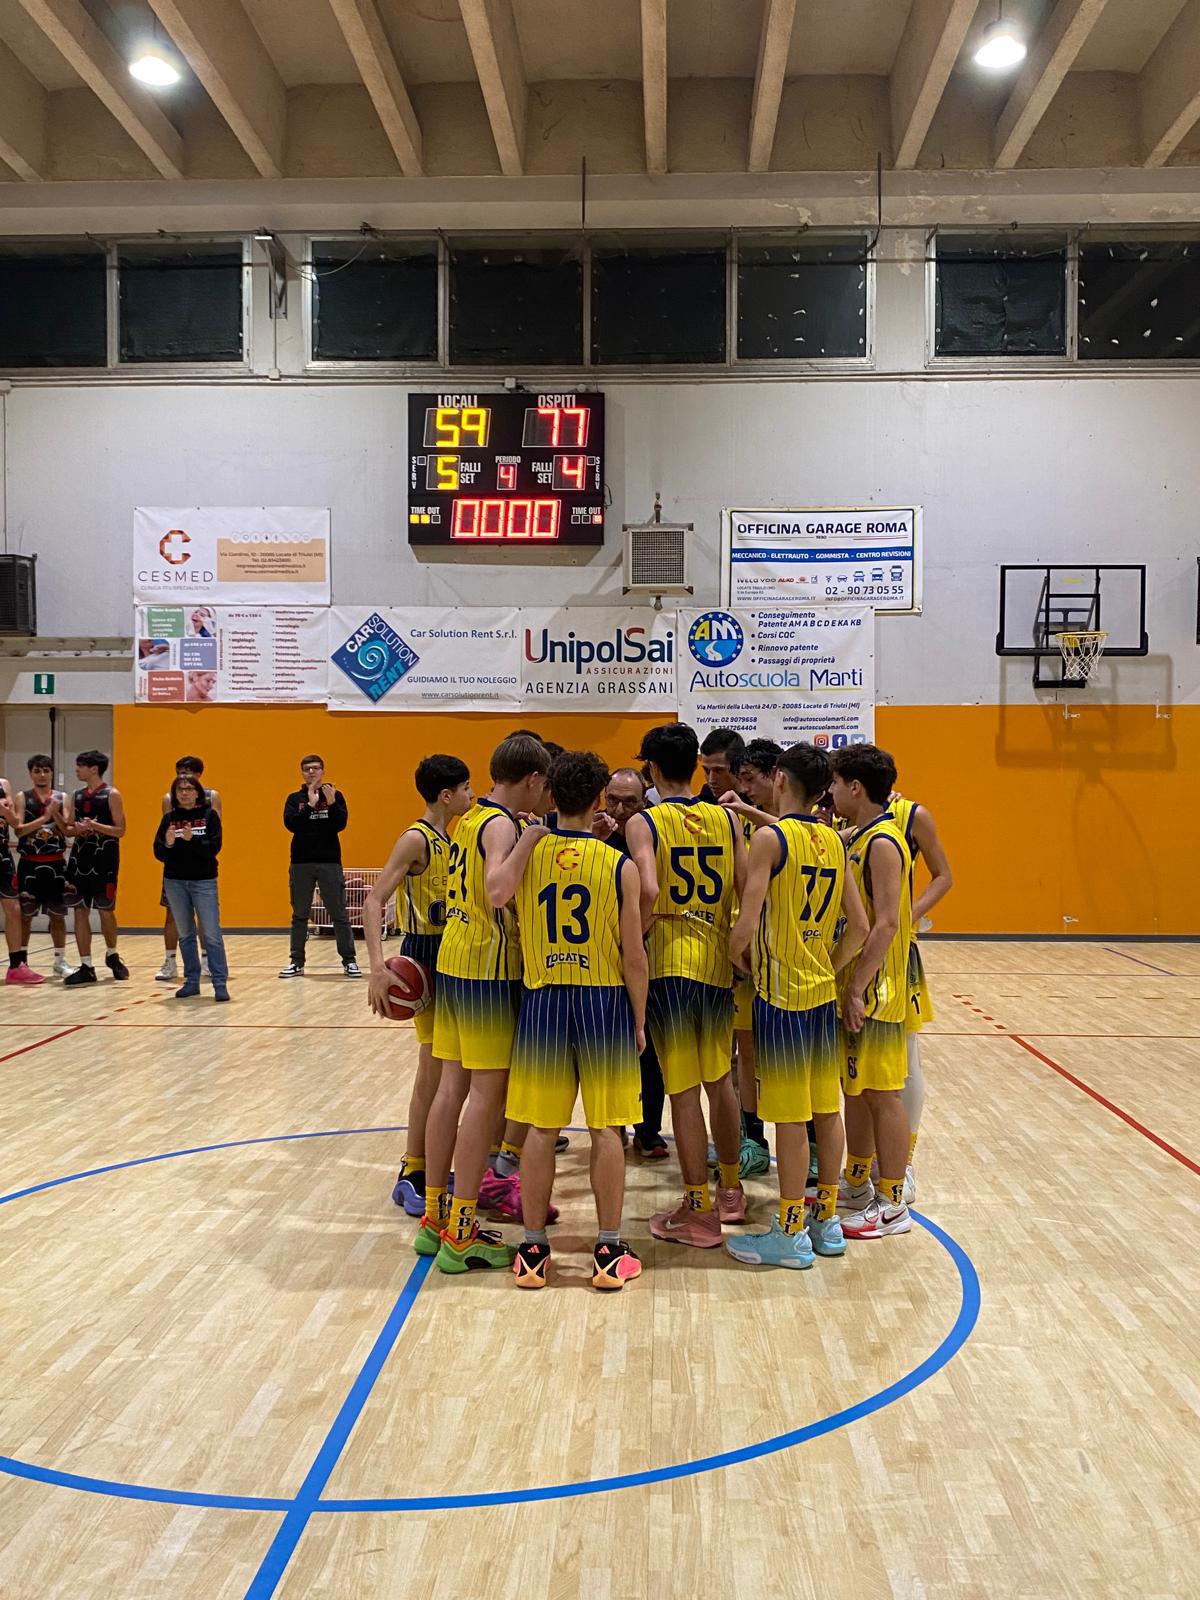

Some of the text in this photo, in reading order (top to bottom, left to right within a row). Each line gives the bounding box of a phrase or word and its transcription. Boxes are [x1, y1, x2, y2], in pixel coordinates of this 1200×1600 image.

[437, 394, 478, 408] LOCALI
[538, 394, 576, 408] OSPITI
[436, 408, 486, 447] 59
[538, 408, 586, 447] 77
[436, 456, 458, 490] 5
[460, 462, 481, 473] FALLI
[531, 462, 552, 473] FALLI
[561, 456, 583, 489] 4
[460, 473, 475, 484] SET
[500, 465, 514, 489] 4
[537, 473, 553, 484] SET
[410, 507, 440, 515] TIME OUT
[572, 507, 601, 515] TIME OUT
[737, 522, 908, 535] OFFICINA GARAGE ROMA
[138, 570, 214, 582] CESMED
[825, 586, 904, 594] 02 90 73 05 55
[758, 612, 816, 620] Conseguimento
[410, 629, 517, 638] Car Solution Rent S.r.l.
[695, 620, 737, 640] AM
[346, 624, 374, 653] CAR
[368, 616, 418, 667] SOLUTION
[525, 628, 674, 674] UnipolSai
[790, 644, 818, 652] patente
[758, 657, 792, 666] Passaggi
[800, 656, 836, 665] proprietà
[368, 659, 406, 700] RENT
[690, 669, 862, 692] Autoscuola Marti
[526, 682, 673, 694] AGENZIA GRASSANI
[670, 846, 724, 905] 55
[800, 865, 837, 923] 77
[538, 883, 591, 944] 13
[546, 953, 590, 970] LOCATE
[456, 1206, 474, 1242] CBL
